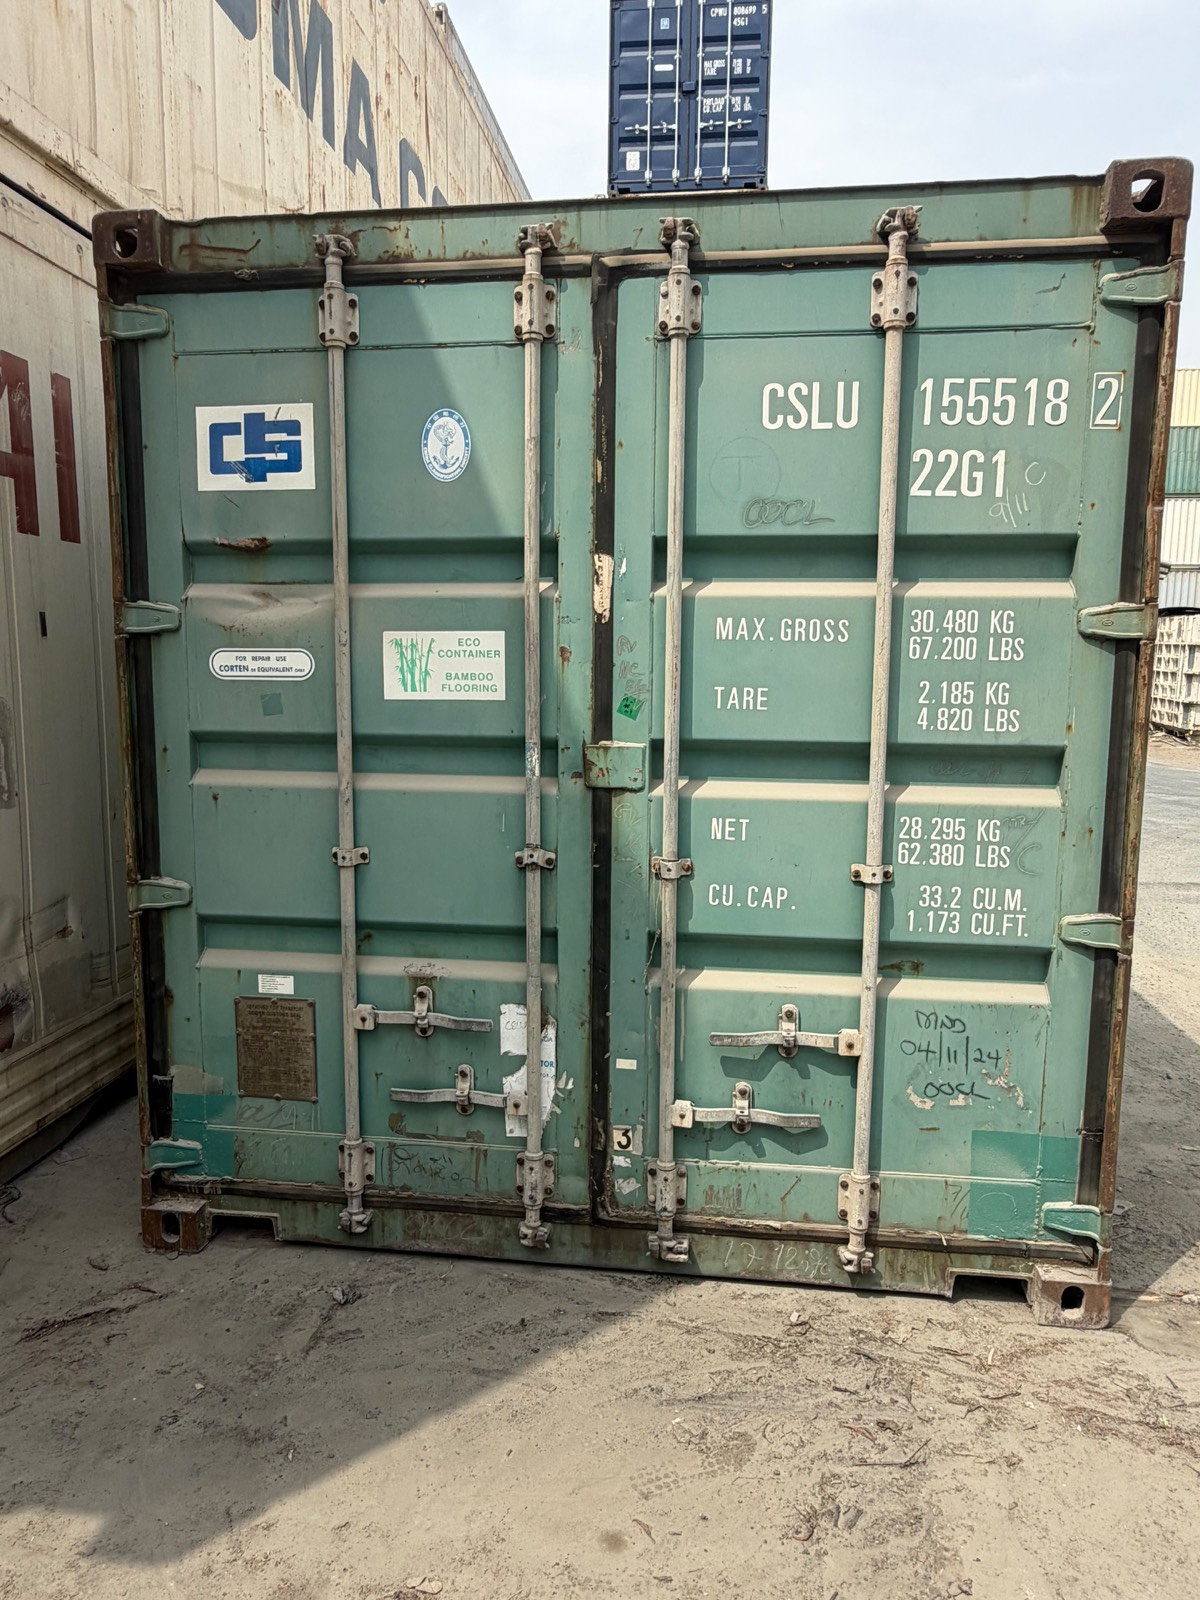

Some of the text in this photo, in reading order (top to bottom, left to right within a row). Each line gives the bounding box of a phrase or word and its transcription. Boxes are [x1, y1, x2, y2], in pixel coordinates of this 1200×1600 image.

[733, 17, 748, 26] 45G1
[762, 4, 767, 14] 5
[762, 377, 1119, 430] CSLU 155518 2
[909, 448, 1007, 498] 22G1
[989, 609, 1016, 634] KG
[437, 649, 501, 658] CONTAINER
[457, 638, 481, 647] ECO
[987, 636, 1026, 662] LBS
[219, 664, 249, 673] CORTEN
[445, 672, 494, 681] BAMBOO
[441, 683, 498, 693] FLOORING
[713, 685, 770, 712] TARE
[985, 680, 1010, 706] KG
[983, 708, 1021, 733] LBS
[711, 817, 751, 842] NET
[976, 818, 1001, 843] KG
[974, 843, 1012, 869] LBS
[918, 885, 963, 910] 33.2
[972, 886, 1029, 913] CU.M.
[970, 911, 1030, 938] CU.FT.
[616, 1130, 632, 1149] 3
